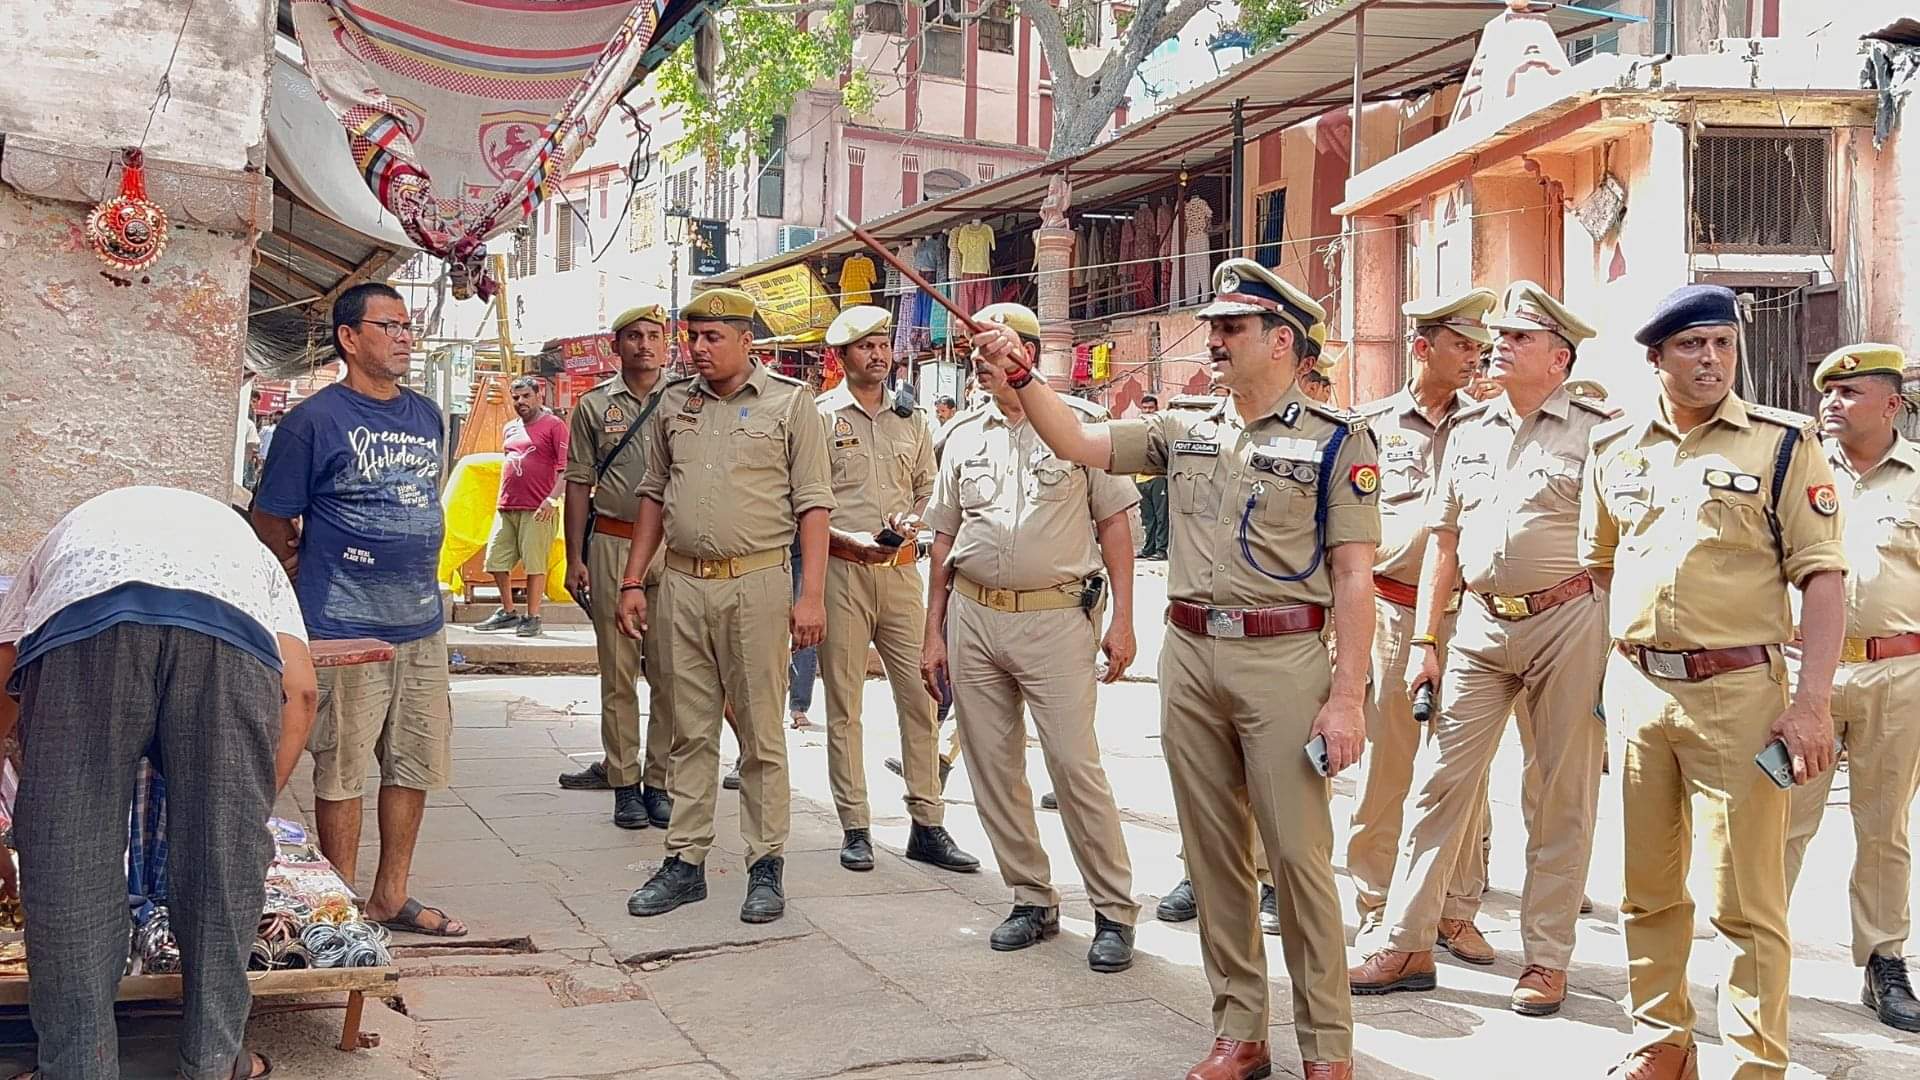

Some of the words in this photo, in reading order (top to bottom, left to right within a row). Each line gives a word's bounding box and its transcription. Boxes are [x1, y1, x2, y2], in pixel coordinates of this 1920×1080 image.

[348, 426, 438, 456] Dreamed
[359, 444, 439, 483] Holidays
[343, 552, 359, 562] PLACE
